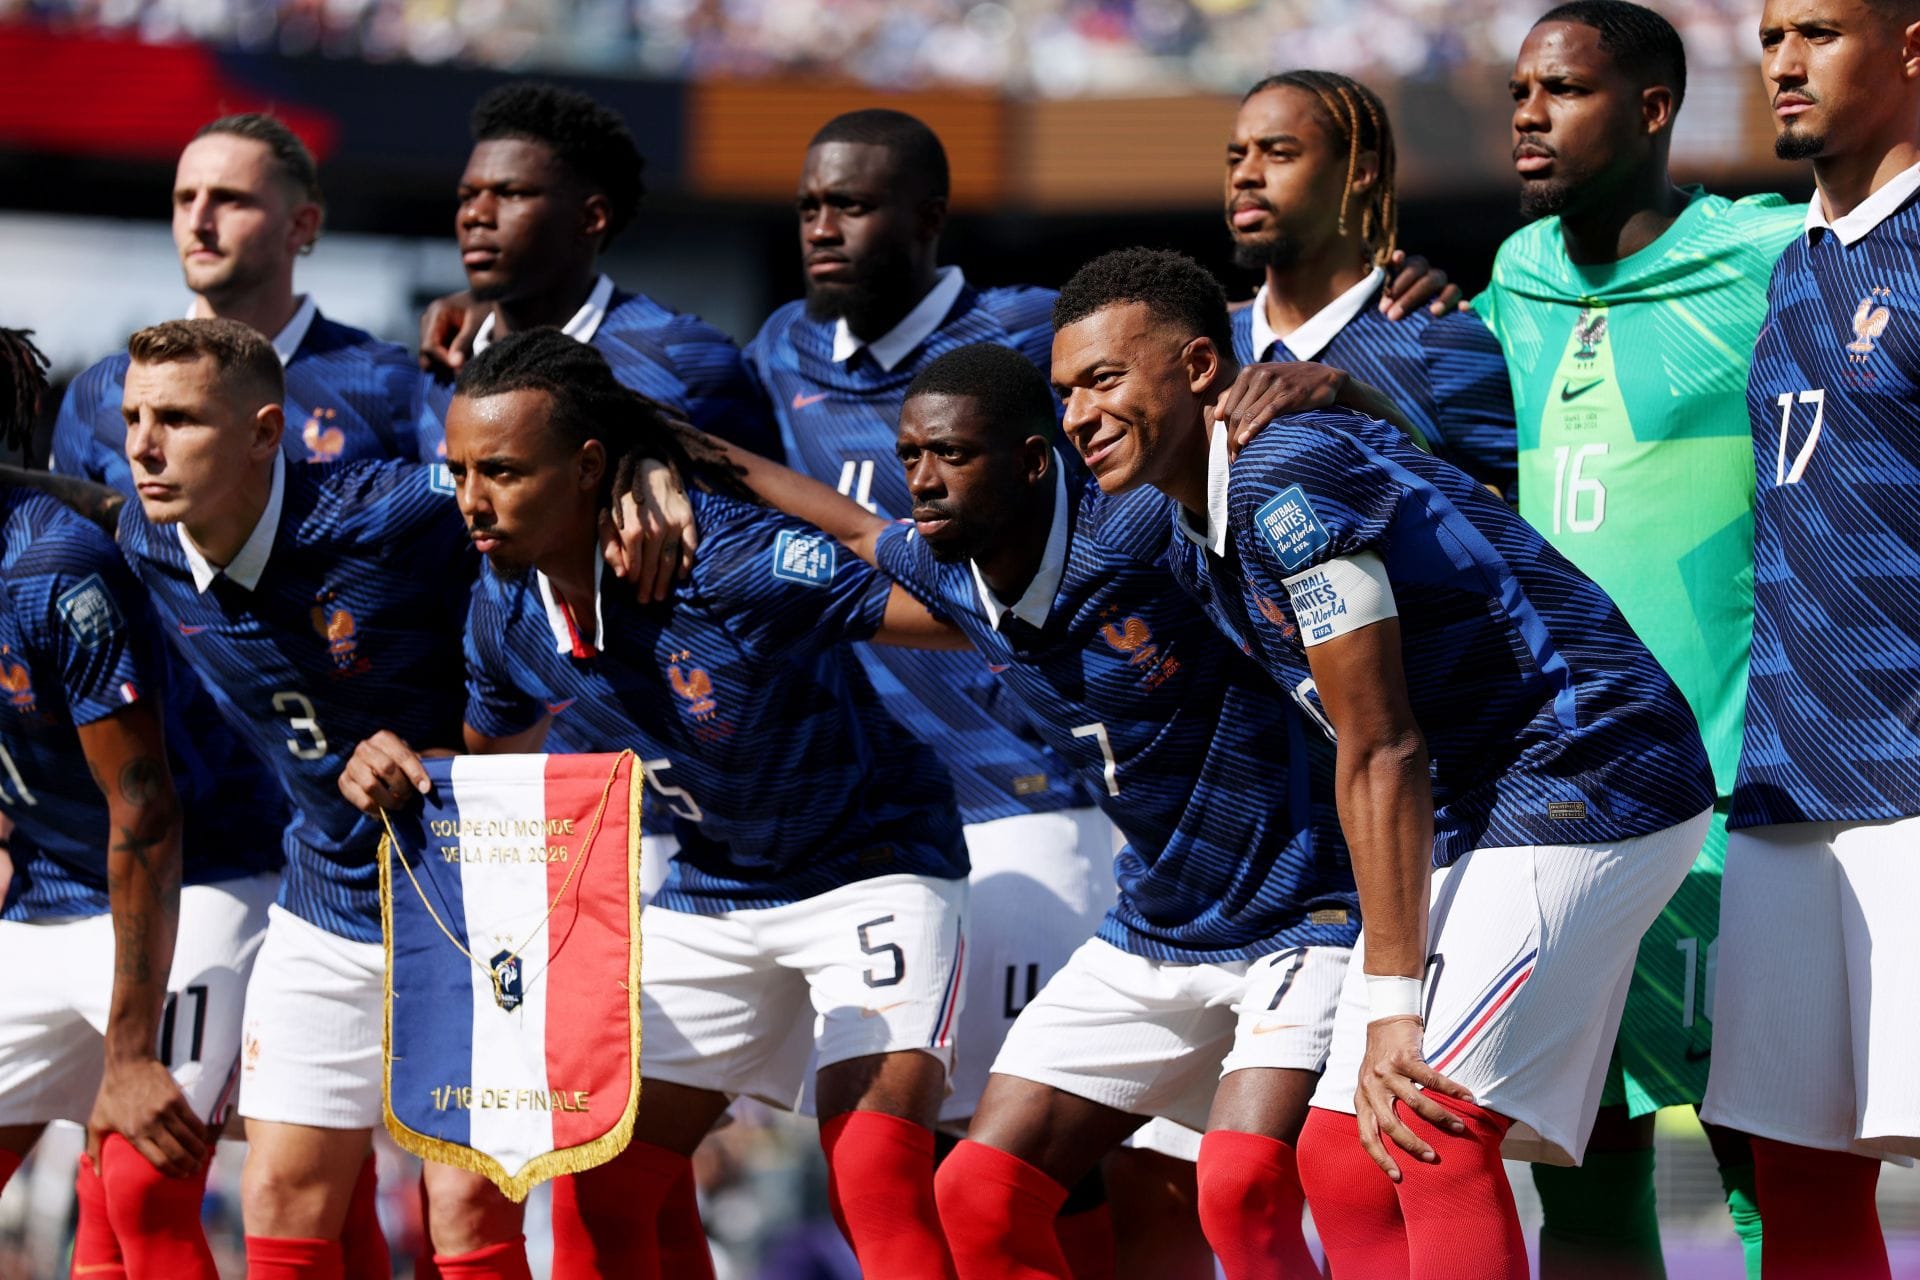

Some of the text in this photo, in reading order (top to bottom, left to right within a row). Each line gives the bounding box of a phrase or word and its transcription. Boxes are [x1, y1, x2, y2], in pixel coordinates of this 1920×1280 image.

[1776, 388, 1825, 486] 17
[1552, 443, 1609, 535] 16
[1263, 500, 1299, 528] FOOTBALL
[1269, 509, 1307, 540] UNITES
[1288, 519, 1316, 544] World
[1293, 541, 1310, 554] FIFA
[1291, 584, 1338, 612] UNITES
[1310, 598, 1347, 624] World
[1313, 624, 1332, 638] FIFA
[271, 691, 327, 760] 3
[1071, 723, 1120, 796] 7
[643, 758, 703, 822] 5
[430, 819, 576, 837] COUPE DU MONDE
[441, 845, 568, 863] DE LA FIFA 2026
[857, 914, 906, 988] 5
[1266, 947, 1309, 1010] 7
[482, 1088, 510, 1109] DE
[517, 1088, 590, 1112] FINALE
